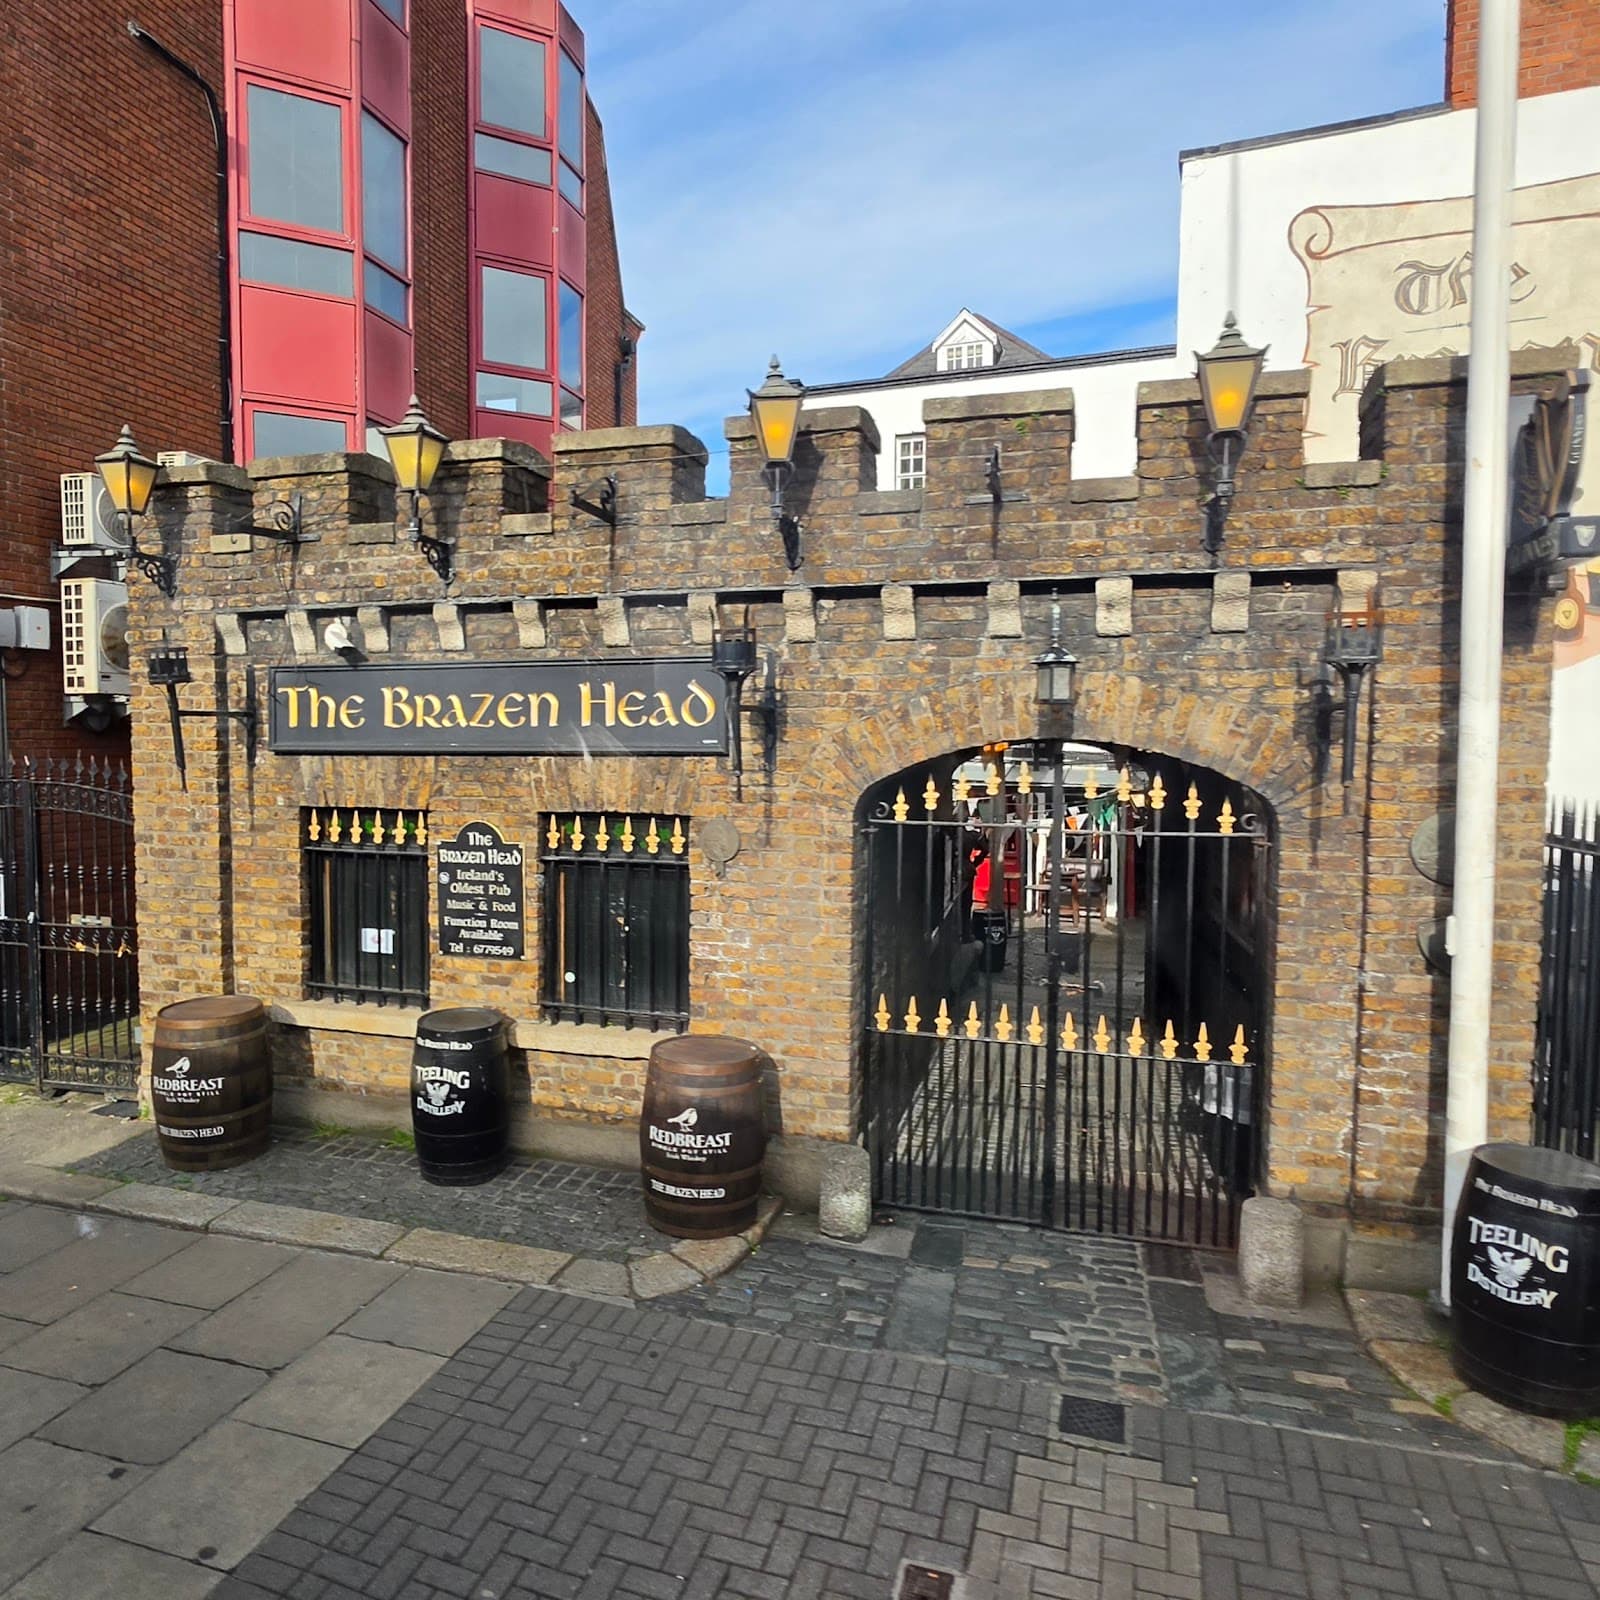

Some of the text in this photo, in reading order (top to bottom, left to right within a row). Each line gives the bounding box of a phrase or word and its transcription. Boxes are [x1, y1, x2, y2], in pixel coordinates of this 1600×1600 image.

[278, 685, 365, 729] The
[467, 832, 493, 846] The
[456, 869, 505, 882] Ireland's
[450, 882, 511, 896] Oldest Pub
[446, 899, 516, 912] Music & Food
[444, 916, 519, 930] Function Room
[459, 929, 504, 941] Available
[153, 1076, 226, 1091] REDBREAST
[414, 1065, 470, 1089] TEELING
[199, 1126, 224, 1138] HEAD
[649, 1125, 733, 1149] REDBREAST
[1468, 1216, 1569, 1273] TEELING
[1467, 1262, 1559, 1309] DISTILLERY
